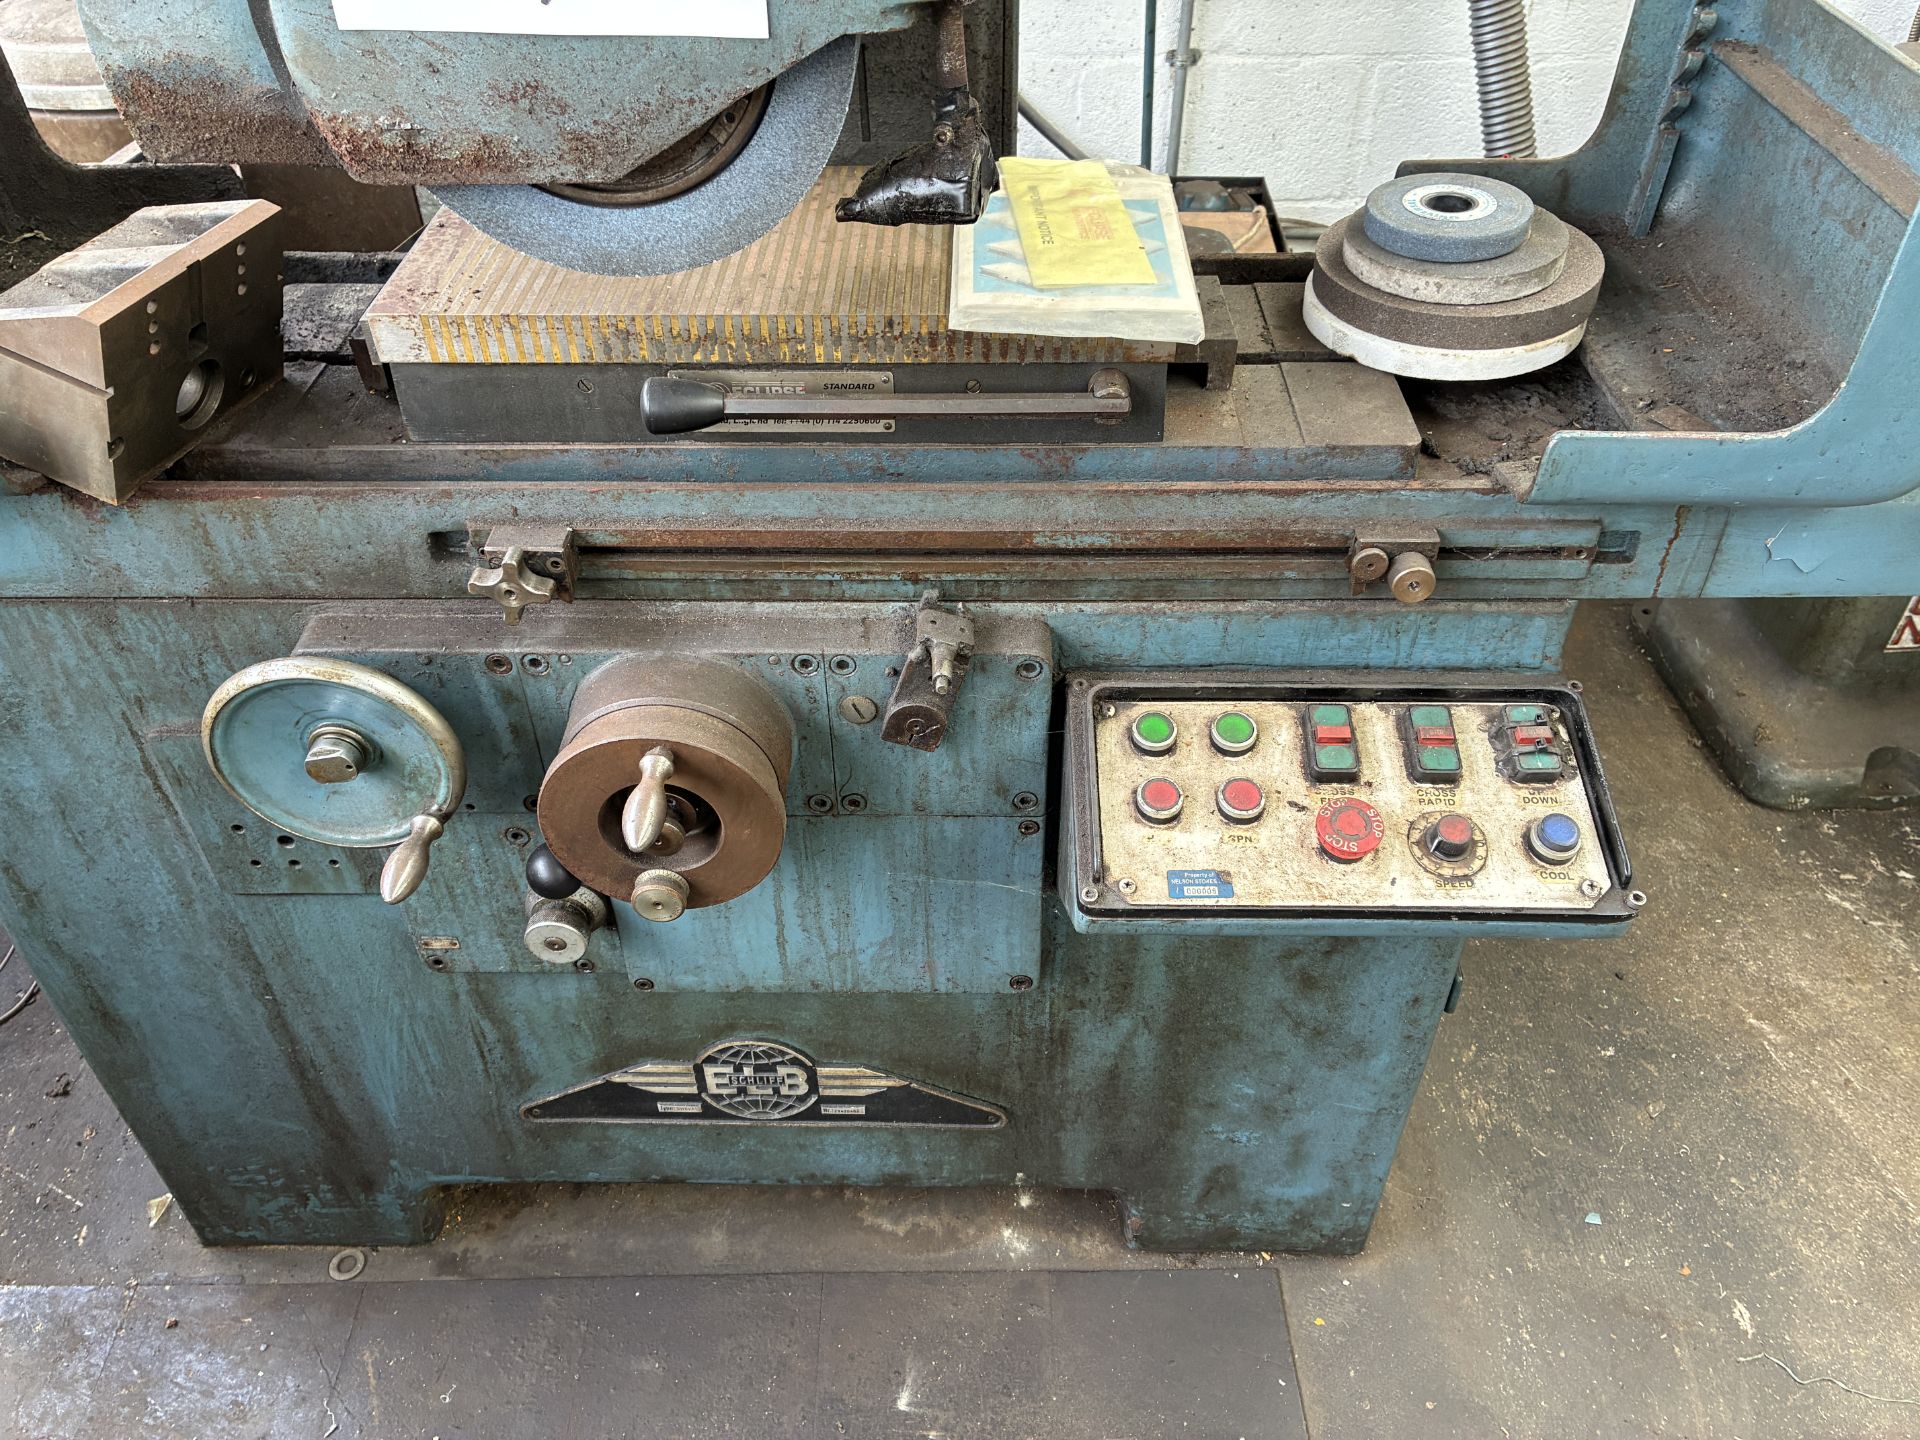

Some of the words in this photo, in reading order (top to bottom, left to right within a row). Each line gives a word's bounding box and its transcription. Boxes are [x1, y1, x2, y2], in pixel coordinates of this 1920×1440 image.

[1035, 221, 1054, 245] NOTICE
[823, 382, 875, 390] STANDARD
[1416, 788, 1457, 798] CROSS
[1522, 796, 1559, 804] DOWN
[1366, 809, 1384, 838] STOP
[1540, 871, 1575, 881] COOL
[1435, 880, 1474, 888] SPEED
[703, 1063, 810, 1096] ELB
[730, 1075, 786, 1087] SCHLIFF
